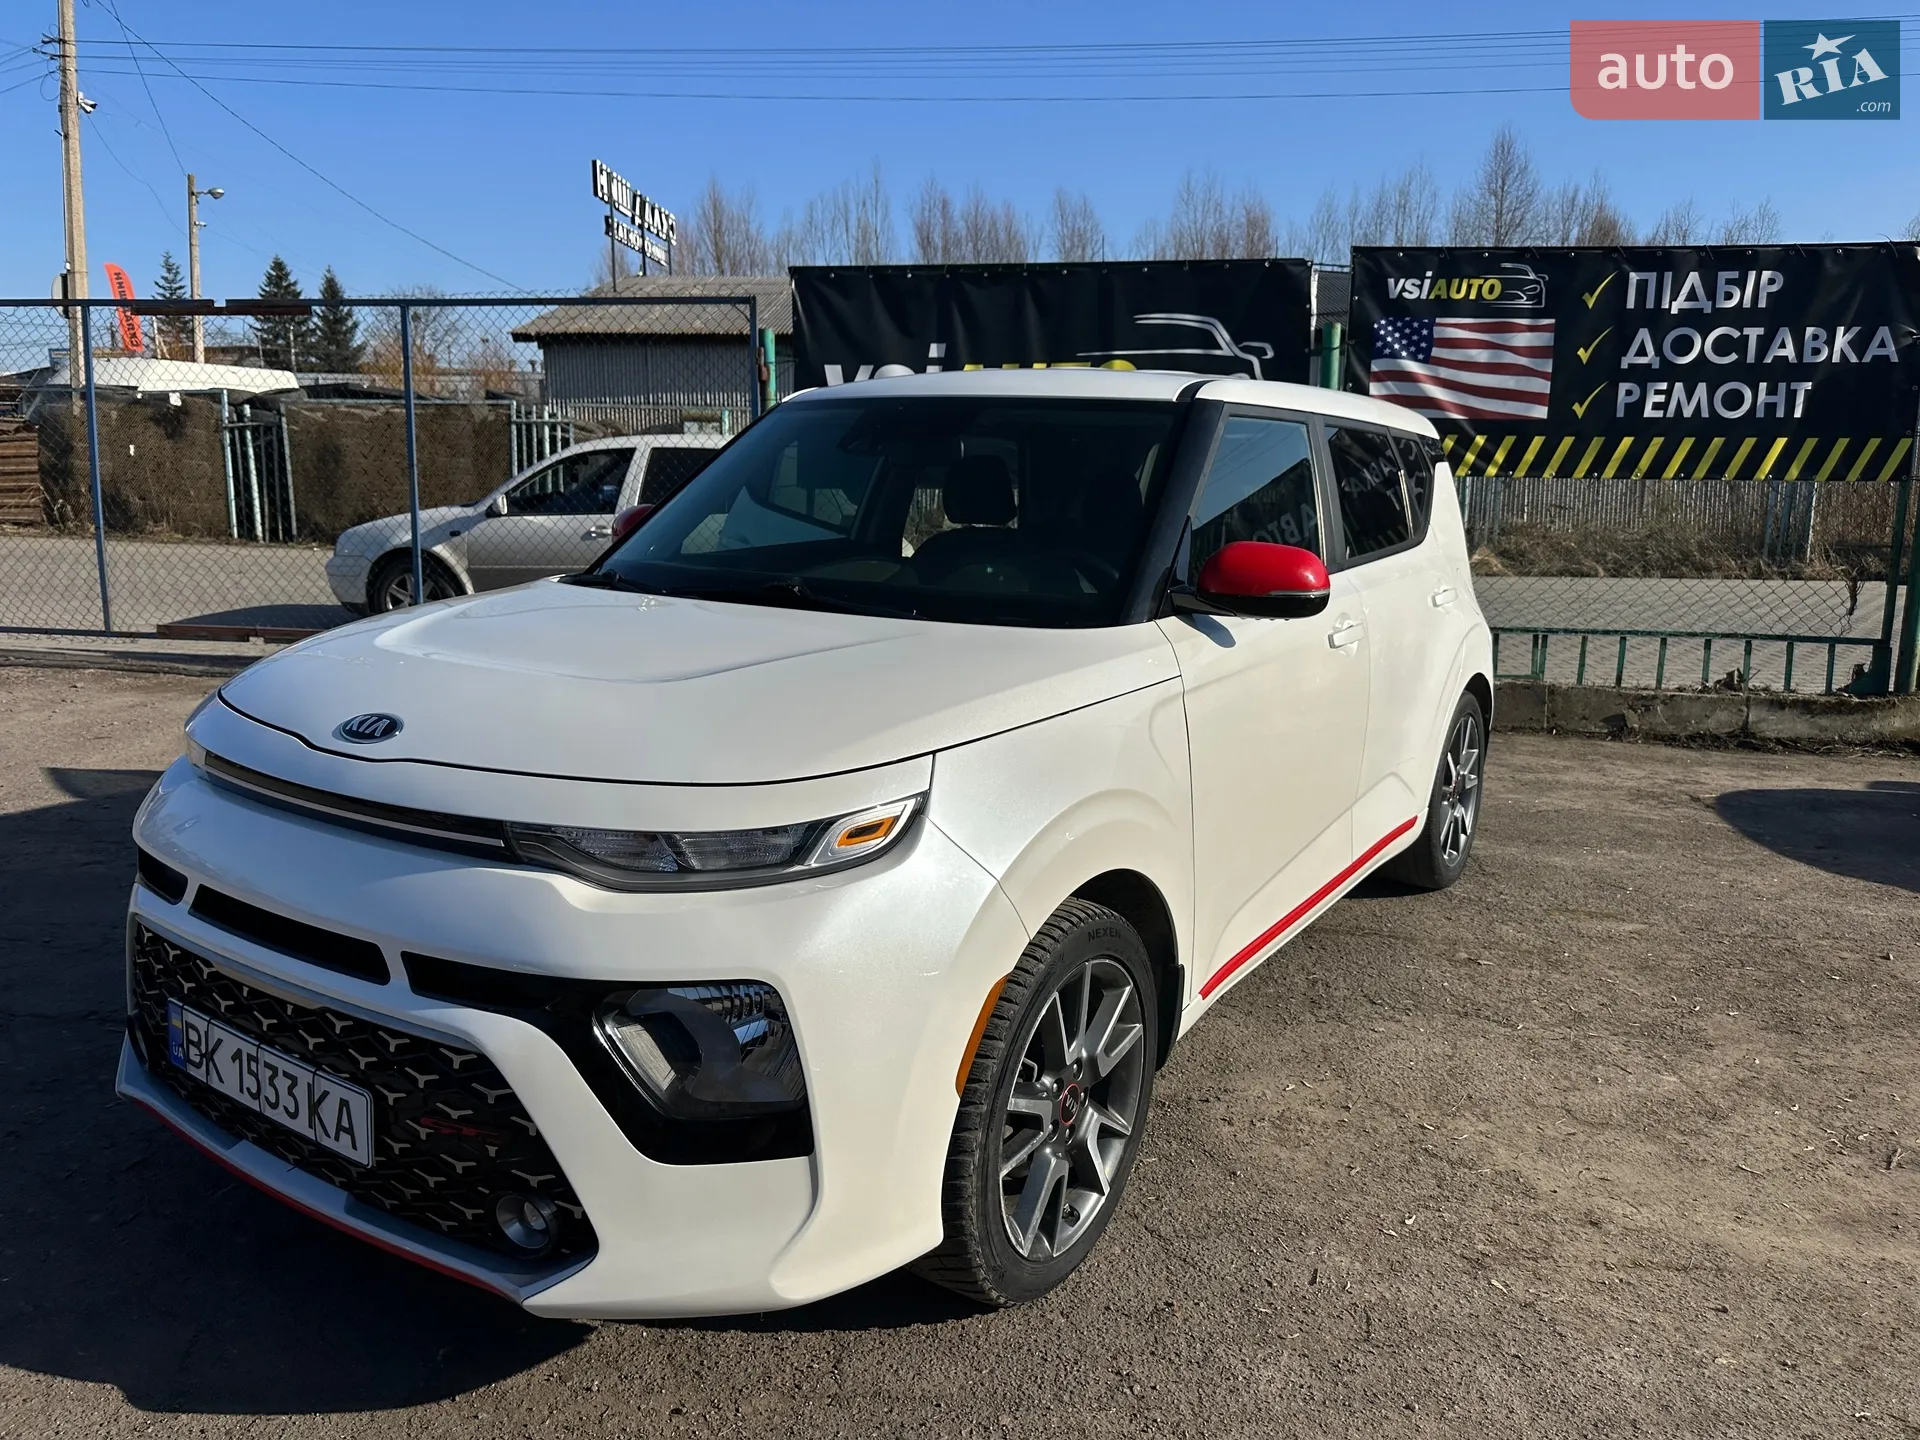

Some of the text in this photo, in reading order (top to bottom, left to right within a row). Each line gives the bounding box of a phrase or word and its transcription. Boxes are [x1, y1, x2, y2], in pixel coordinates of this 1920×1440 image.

[1626, 270, 1784, 314] ПІДБІР
[1620, 326, 1899, 369] ДОСТАВКА
[1616, 381, 1812, 419] РЕМОНТ
[345, 715, 390, 737] KIA
[1087, 926, 1121, 942] NEXEN
[172, 1041, 184, 1060] UA
[185, 1020, 225, 1084] BK
[231, 1047, 300, 1121] 1533
[307, 1081, 358, 1151] KA
